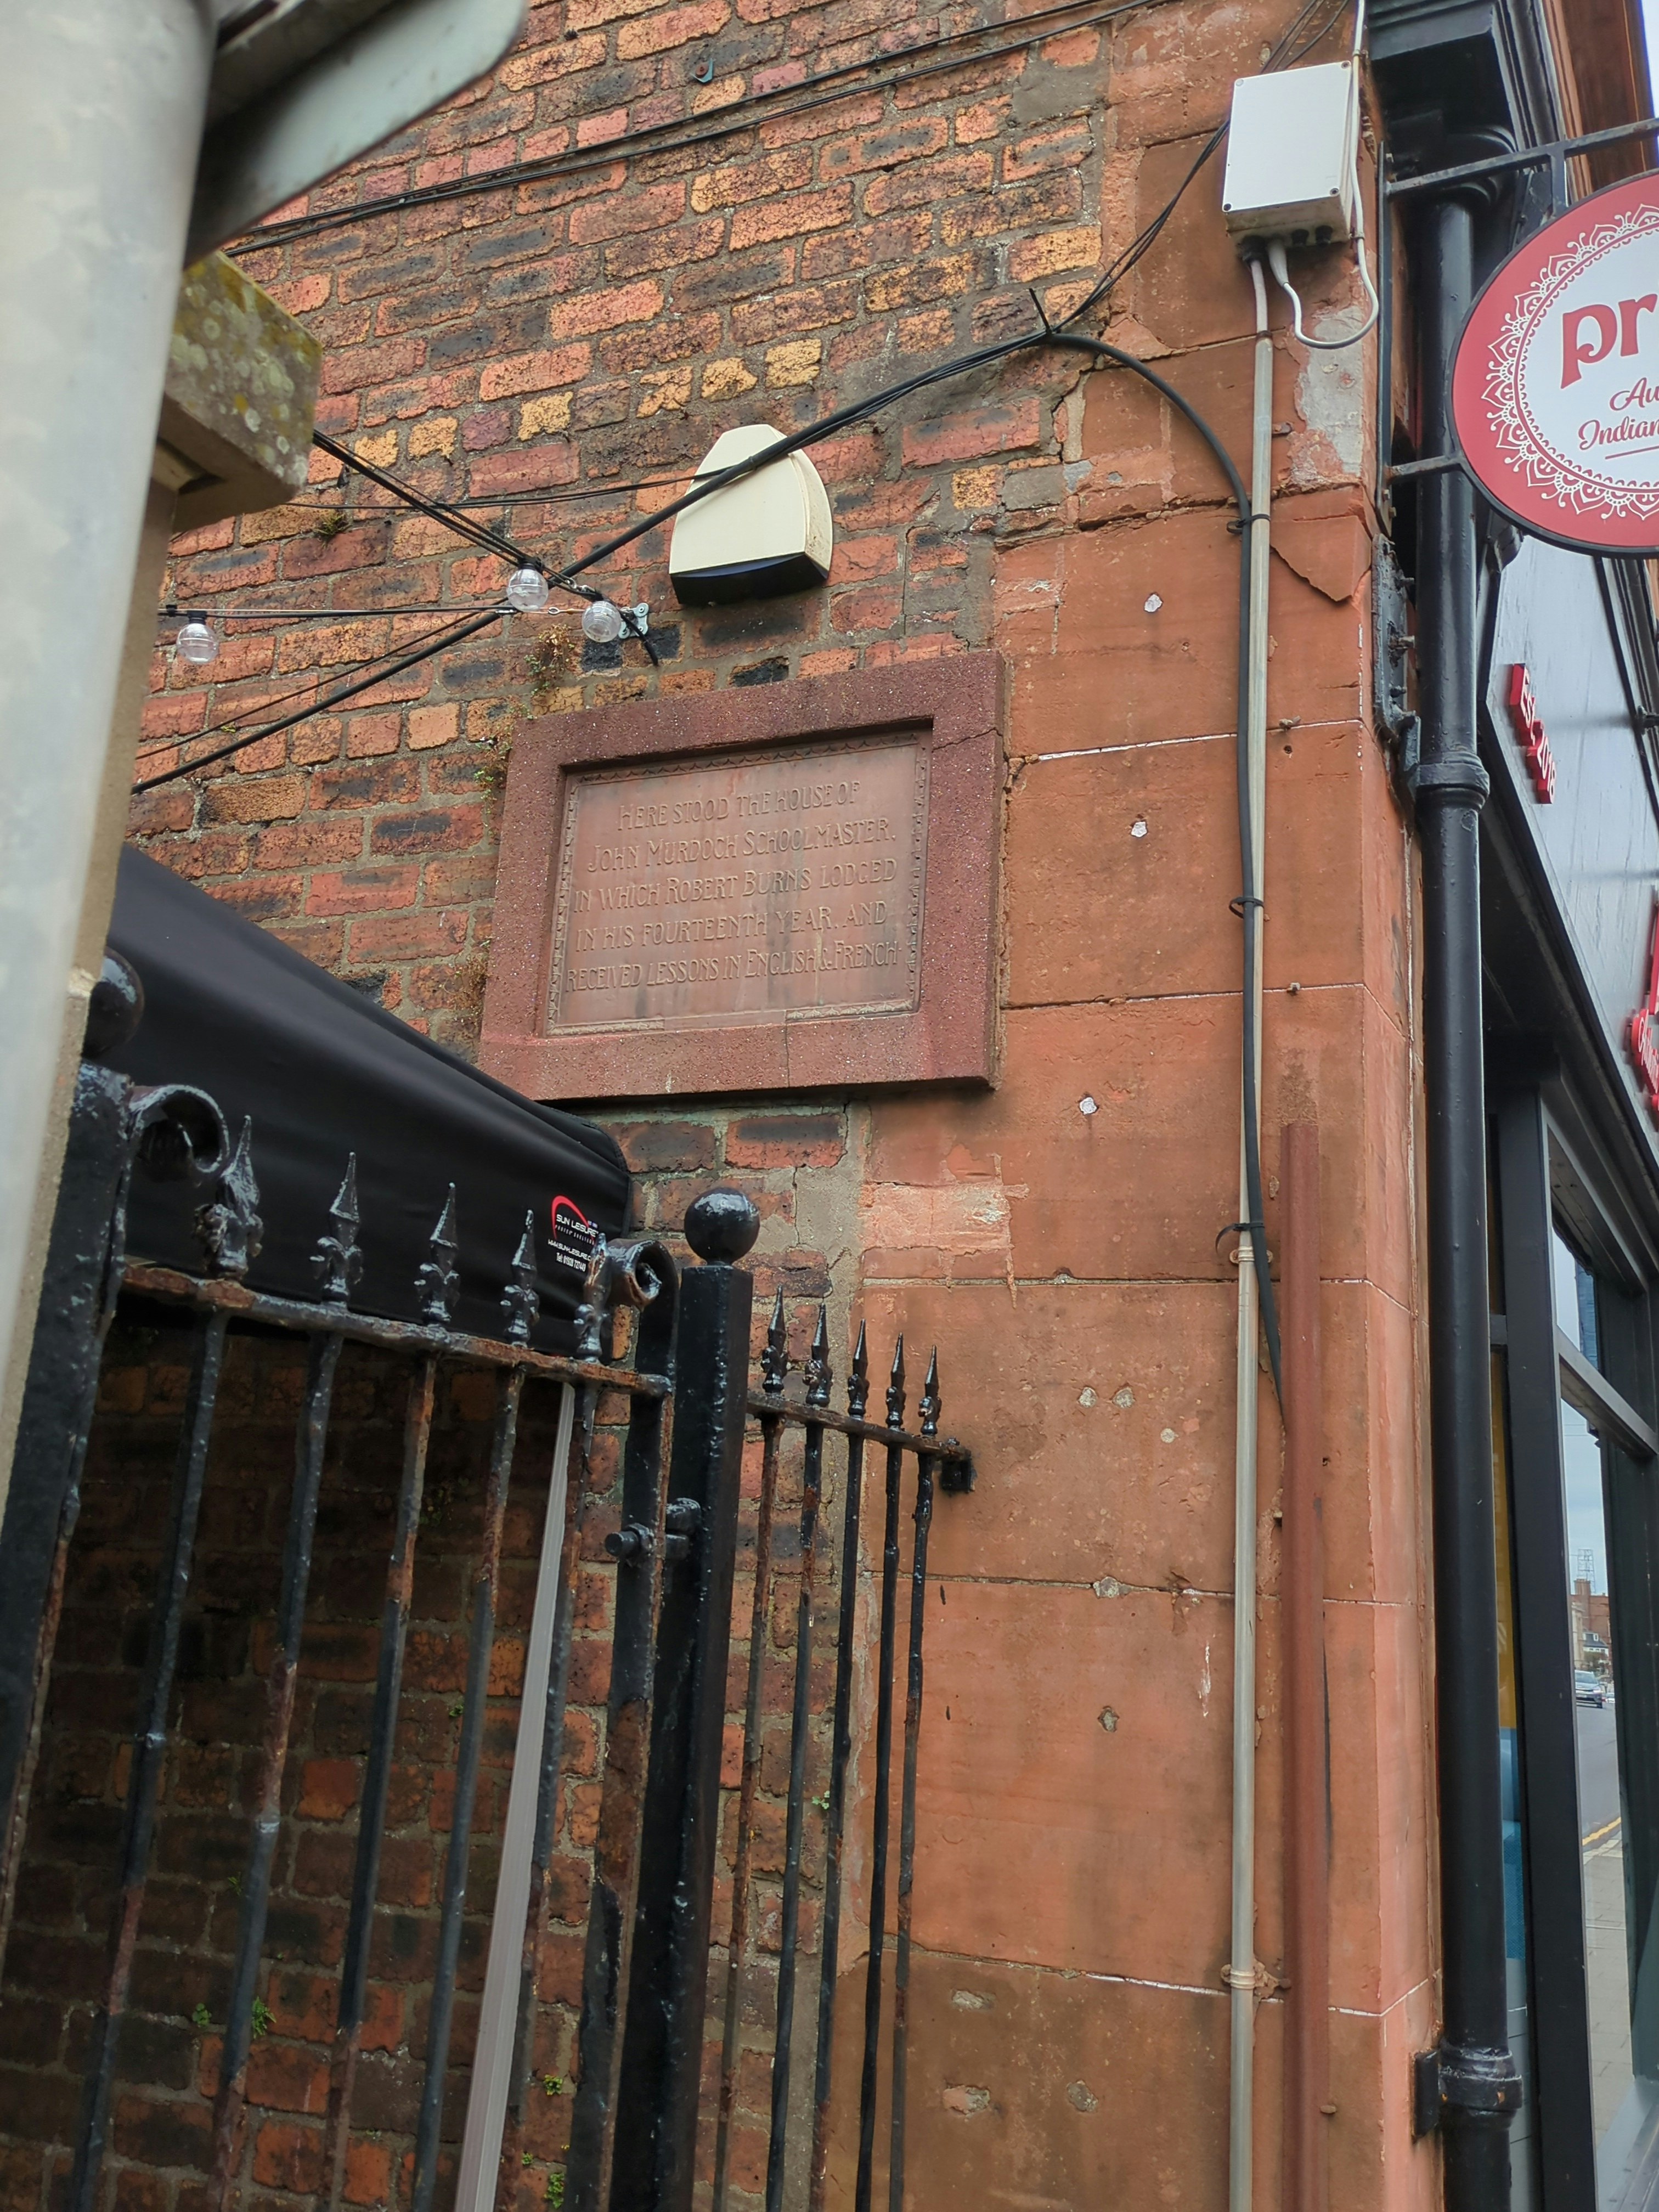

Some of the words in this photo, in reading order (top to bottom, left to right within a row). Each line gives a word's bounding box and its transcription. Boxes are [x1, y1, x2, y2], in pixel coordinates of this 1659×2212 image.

[617, 804, 668, 831] HERE
[673, 797, 729, 823] STOOD
[737, 791, 771, 817] THE
[775, 783, 833, 812] HOUSE
[837, 781, 861, 805] OF
[587, 845, 640, 872] JOHN
[646, 834, 739, 867] MURDOCH
[573, 889, 592, 913] IN
[599, 883, 661, 910] WHICH
[665, 876, 738, 904] ROBERT
[742, 870, 811, 896] BURNS
[820, 857, 897, 888] LODGED
[576, 928, 597, 952] IN
[602, 926, 635, 949] HIS
[641, 911, 769, 946] FOURTEENTH
[842, 900, 887, 927] AND
[565, 964, 642, 992] RECEIVED
[646, 958, 719, 986] LESSONS
[722, 955, 742, 980] IN
[744, 948, 817, 978] ENGLISH
[556, 1214, 570, 1226] SUN
